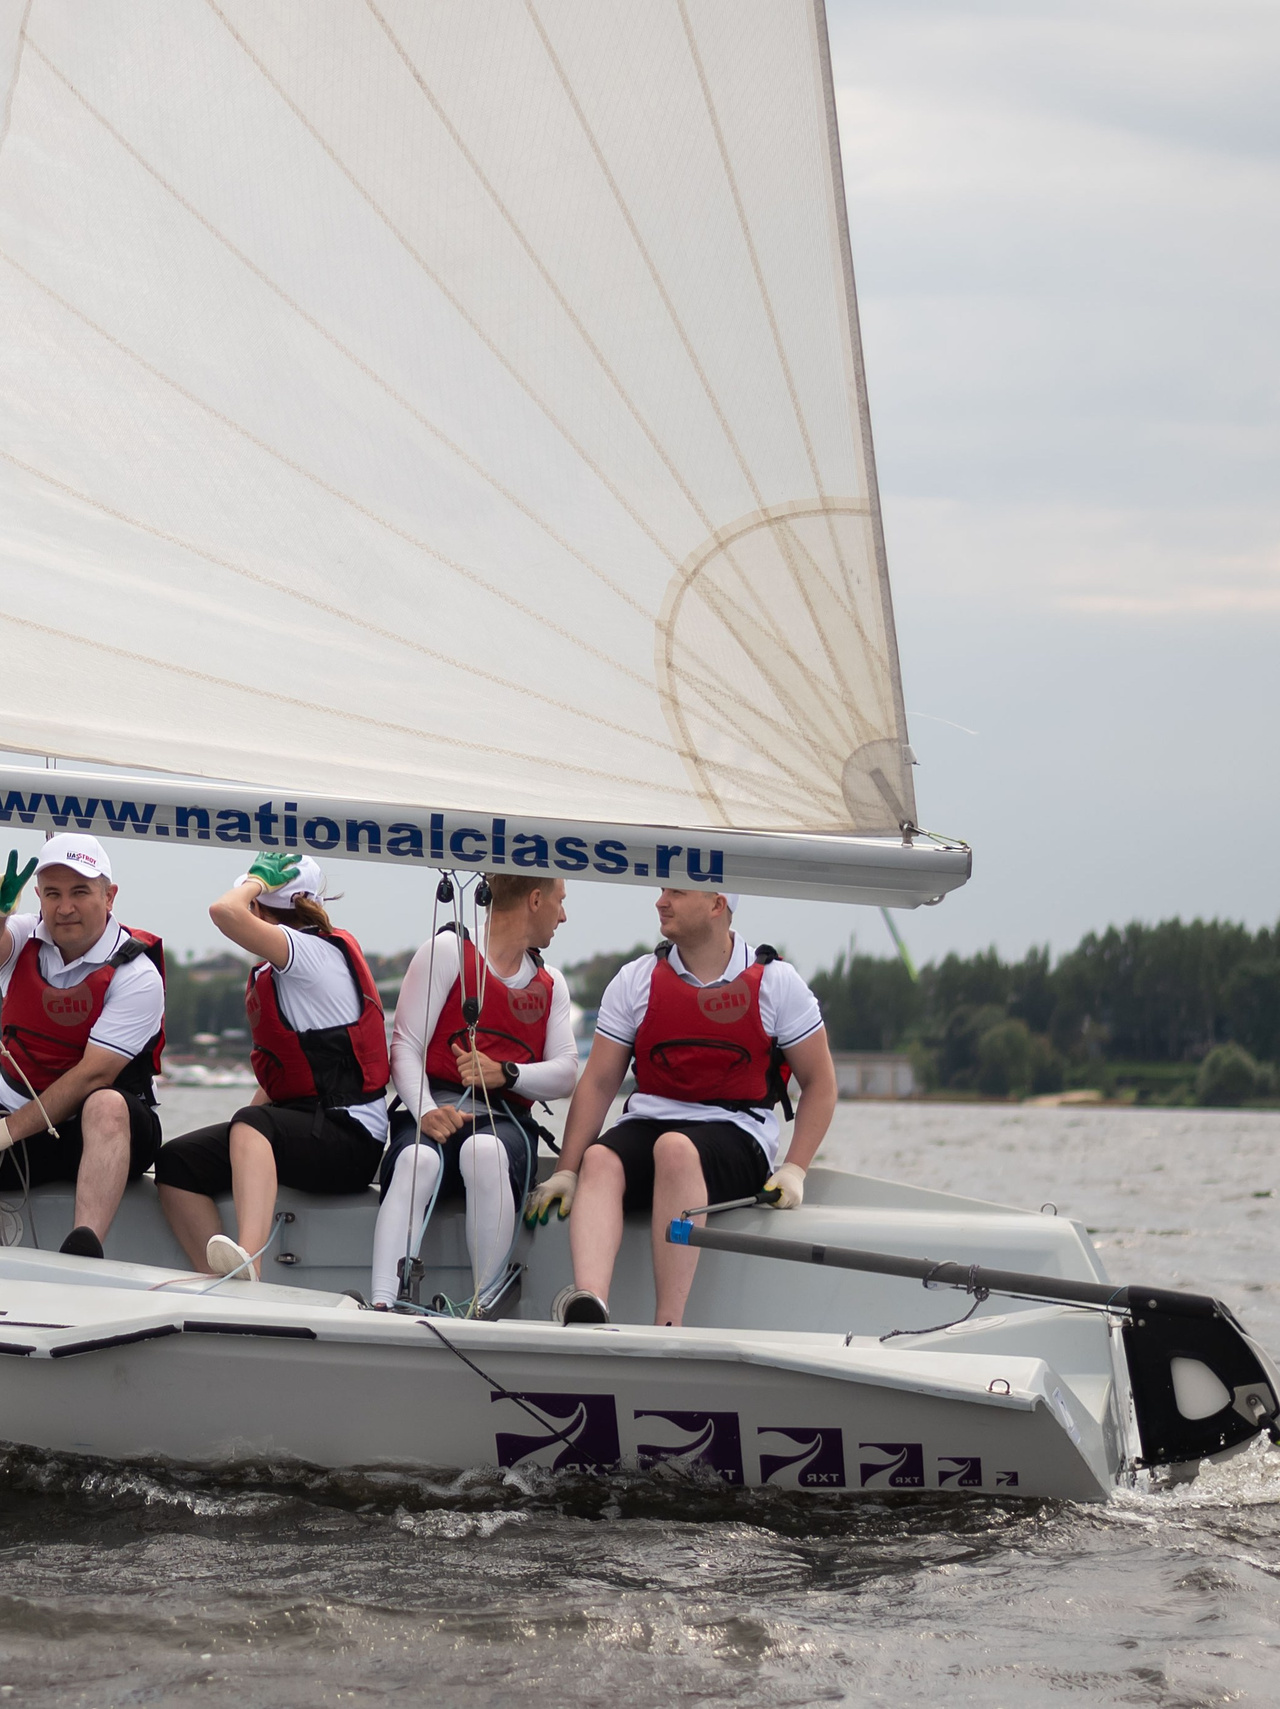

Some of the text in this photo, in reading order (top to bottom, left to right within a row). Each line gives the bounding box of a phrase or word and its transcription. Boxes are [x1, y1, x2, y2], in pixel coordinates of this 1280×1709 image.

[47, 996, 88, 1013] Gill
[512, 993, 545, 1010] Gill
[703, 992, 747, 1012] Gill
[806, 1473, 839, 1483] ЯХТ
